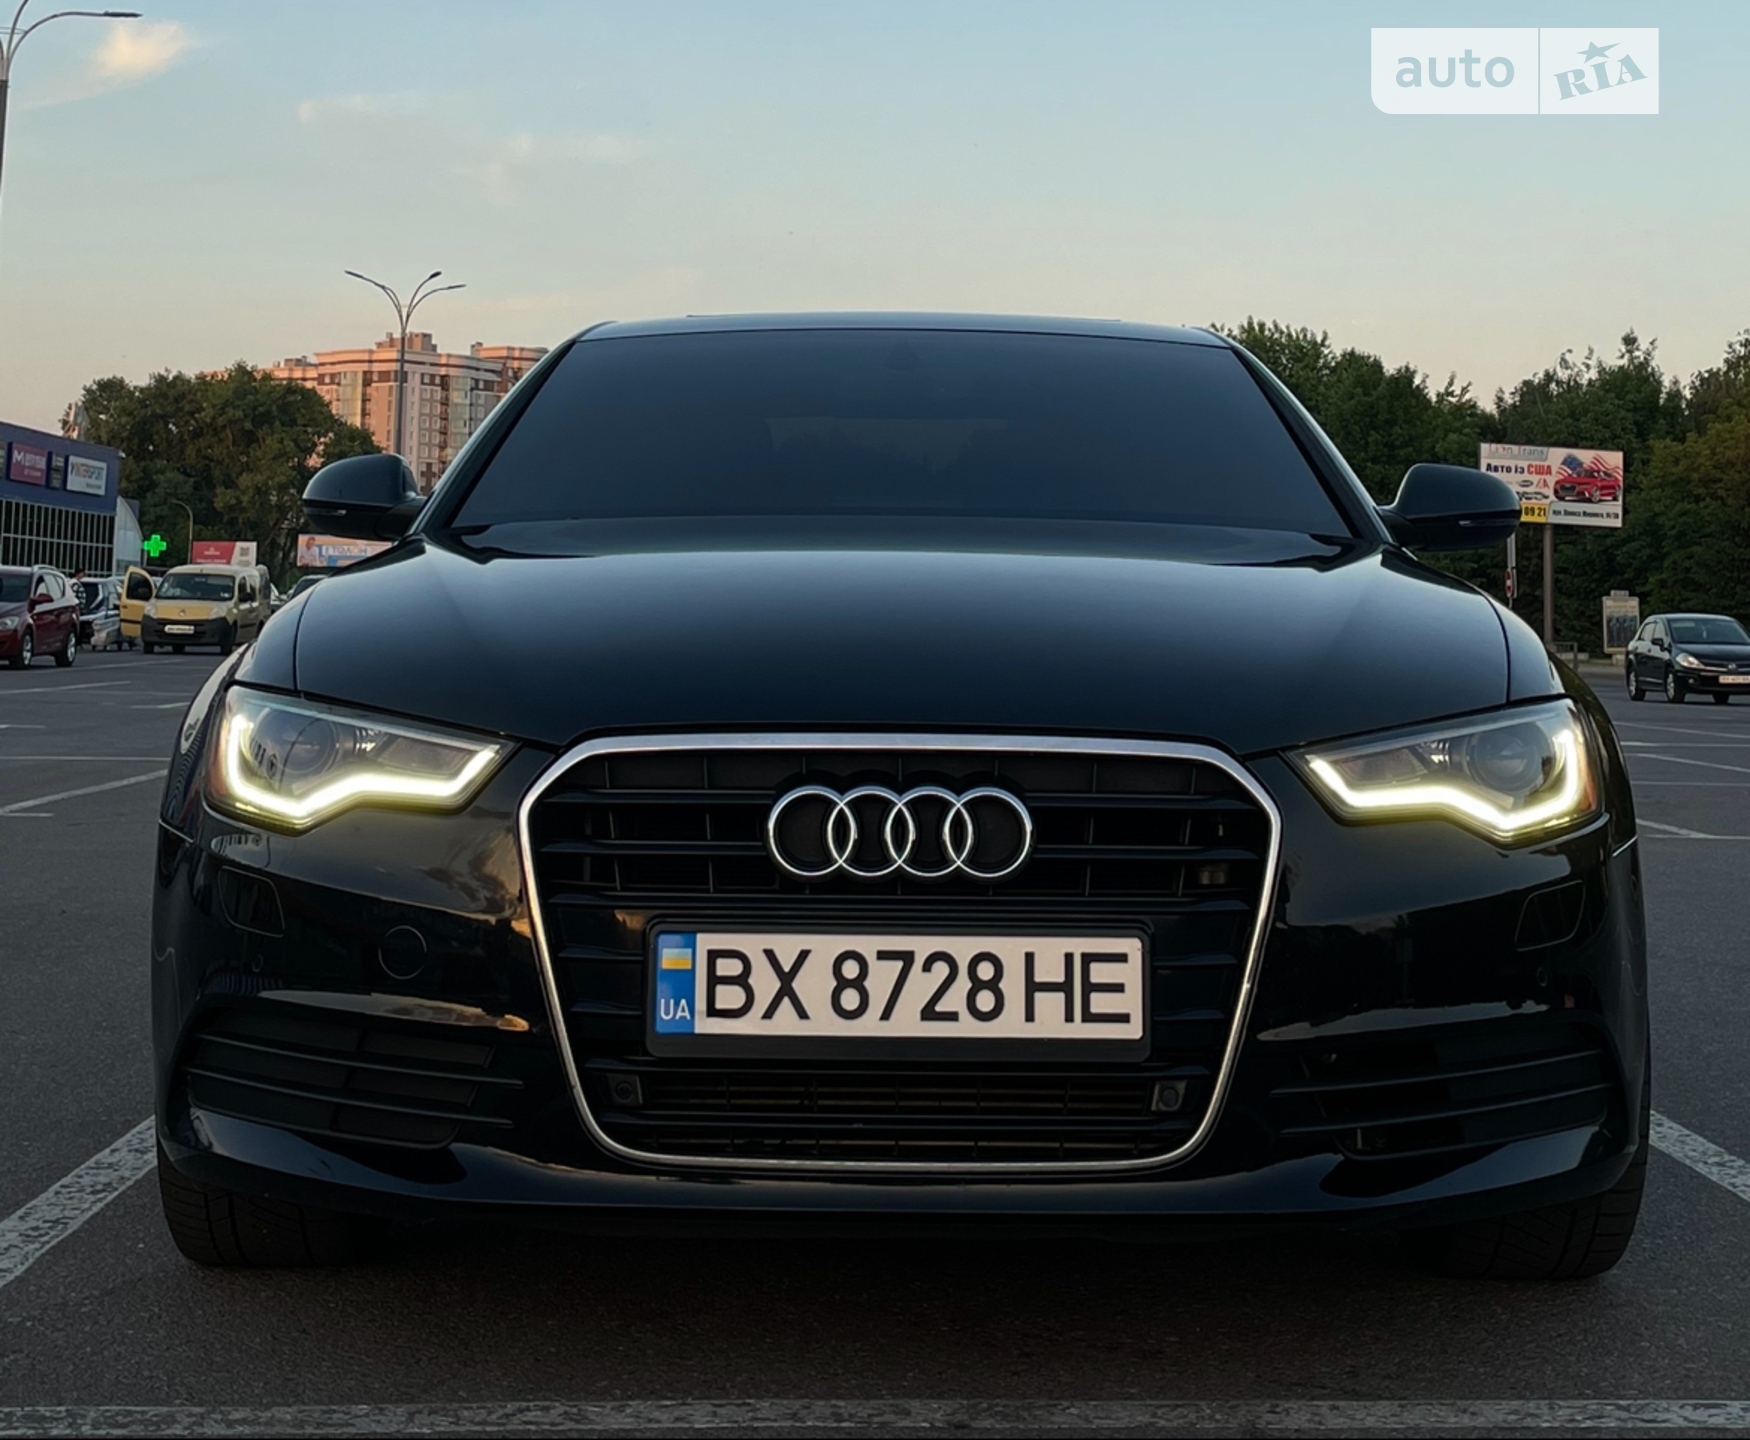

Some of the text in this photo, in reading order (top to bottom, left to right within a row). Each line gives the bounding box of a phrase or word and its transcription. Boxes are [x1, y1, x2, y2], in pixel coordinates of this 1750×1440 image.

[1486, 462, 1512, 473] Авто
[1527, 463, 1552, 476] США
[706, 948, 1131, 1024] BX 8728 HE
[660, 998, 691, 1021] UA
